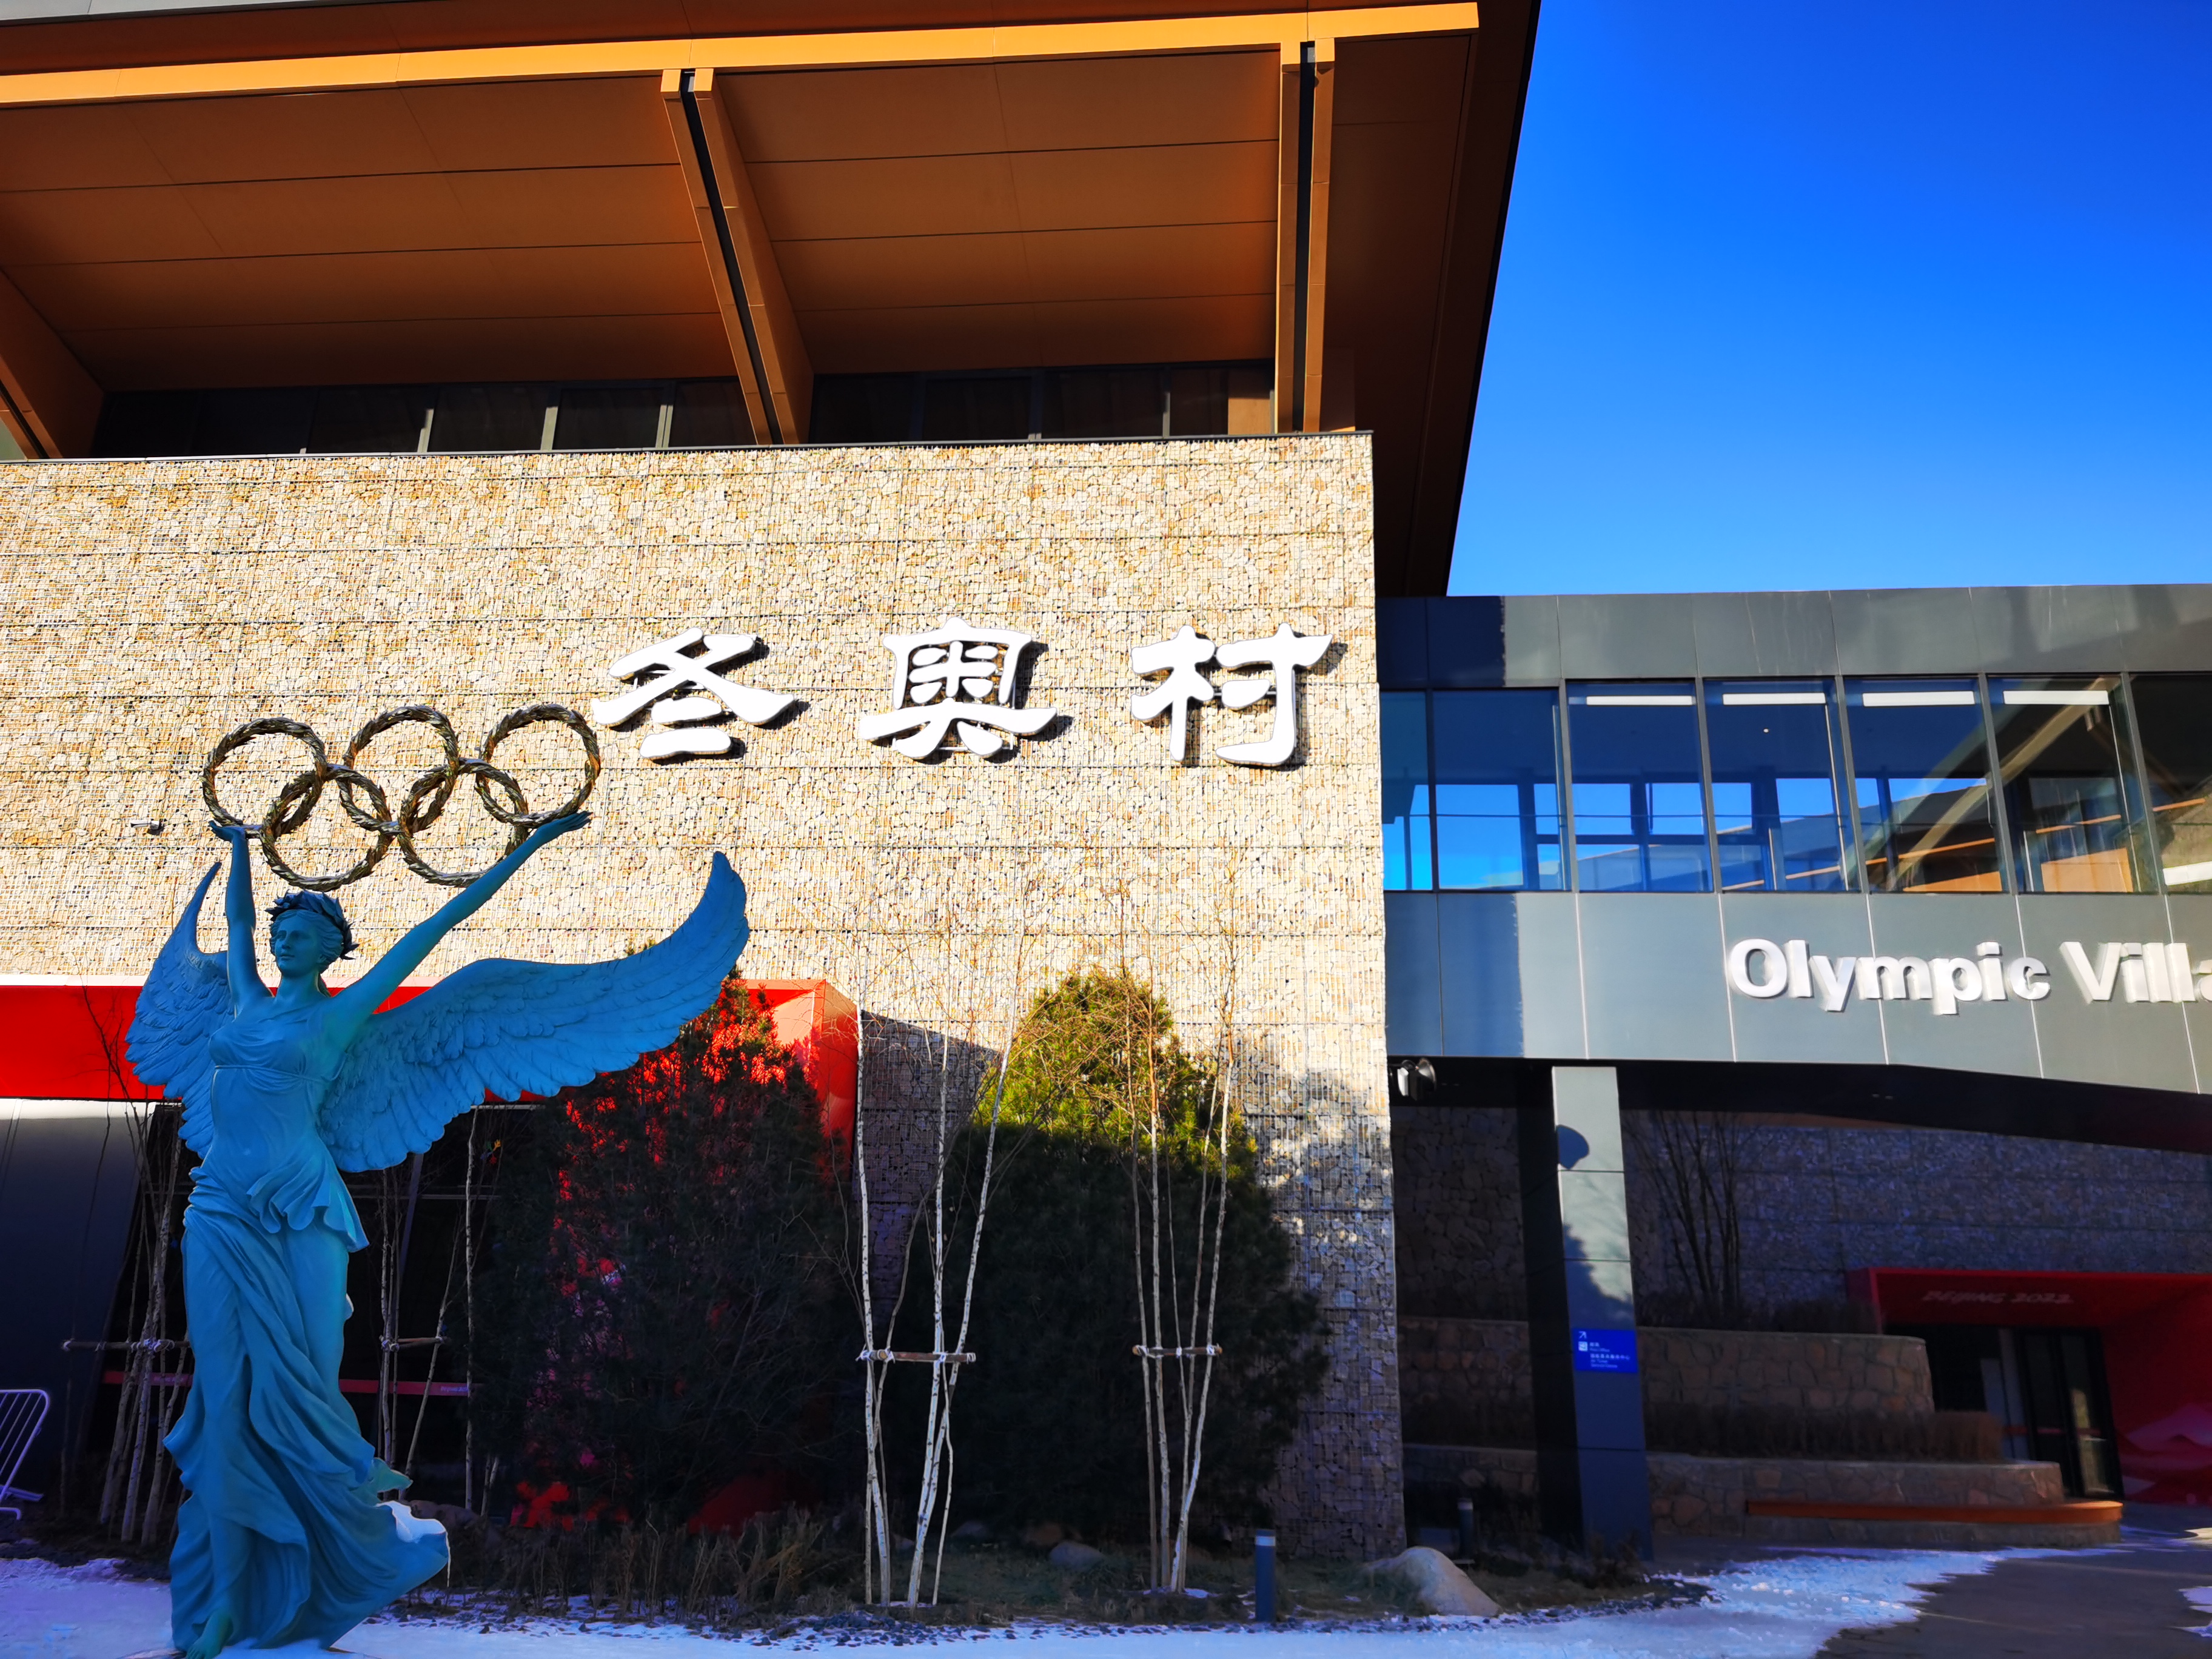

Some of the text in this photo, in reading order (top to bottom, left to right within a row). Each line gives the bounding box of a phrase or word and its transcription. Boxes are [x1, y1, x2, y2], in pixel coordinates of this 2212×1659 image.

[593, 616, 1334, 767] 冬奥村
[1728, 938, 2051, 1015] Olympic
[2010, 1292, 2074, 1305] 2022
